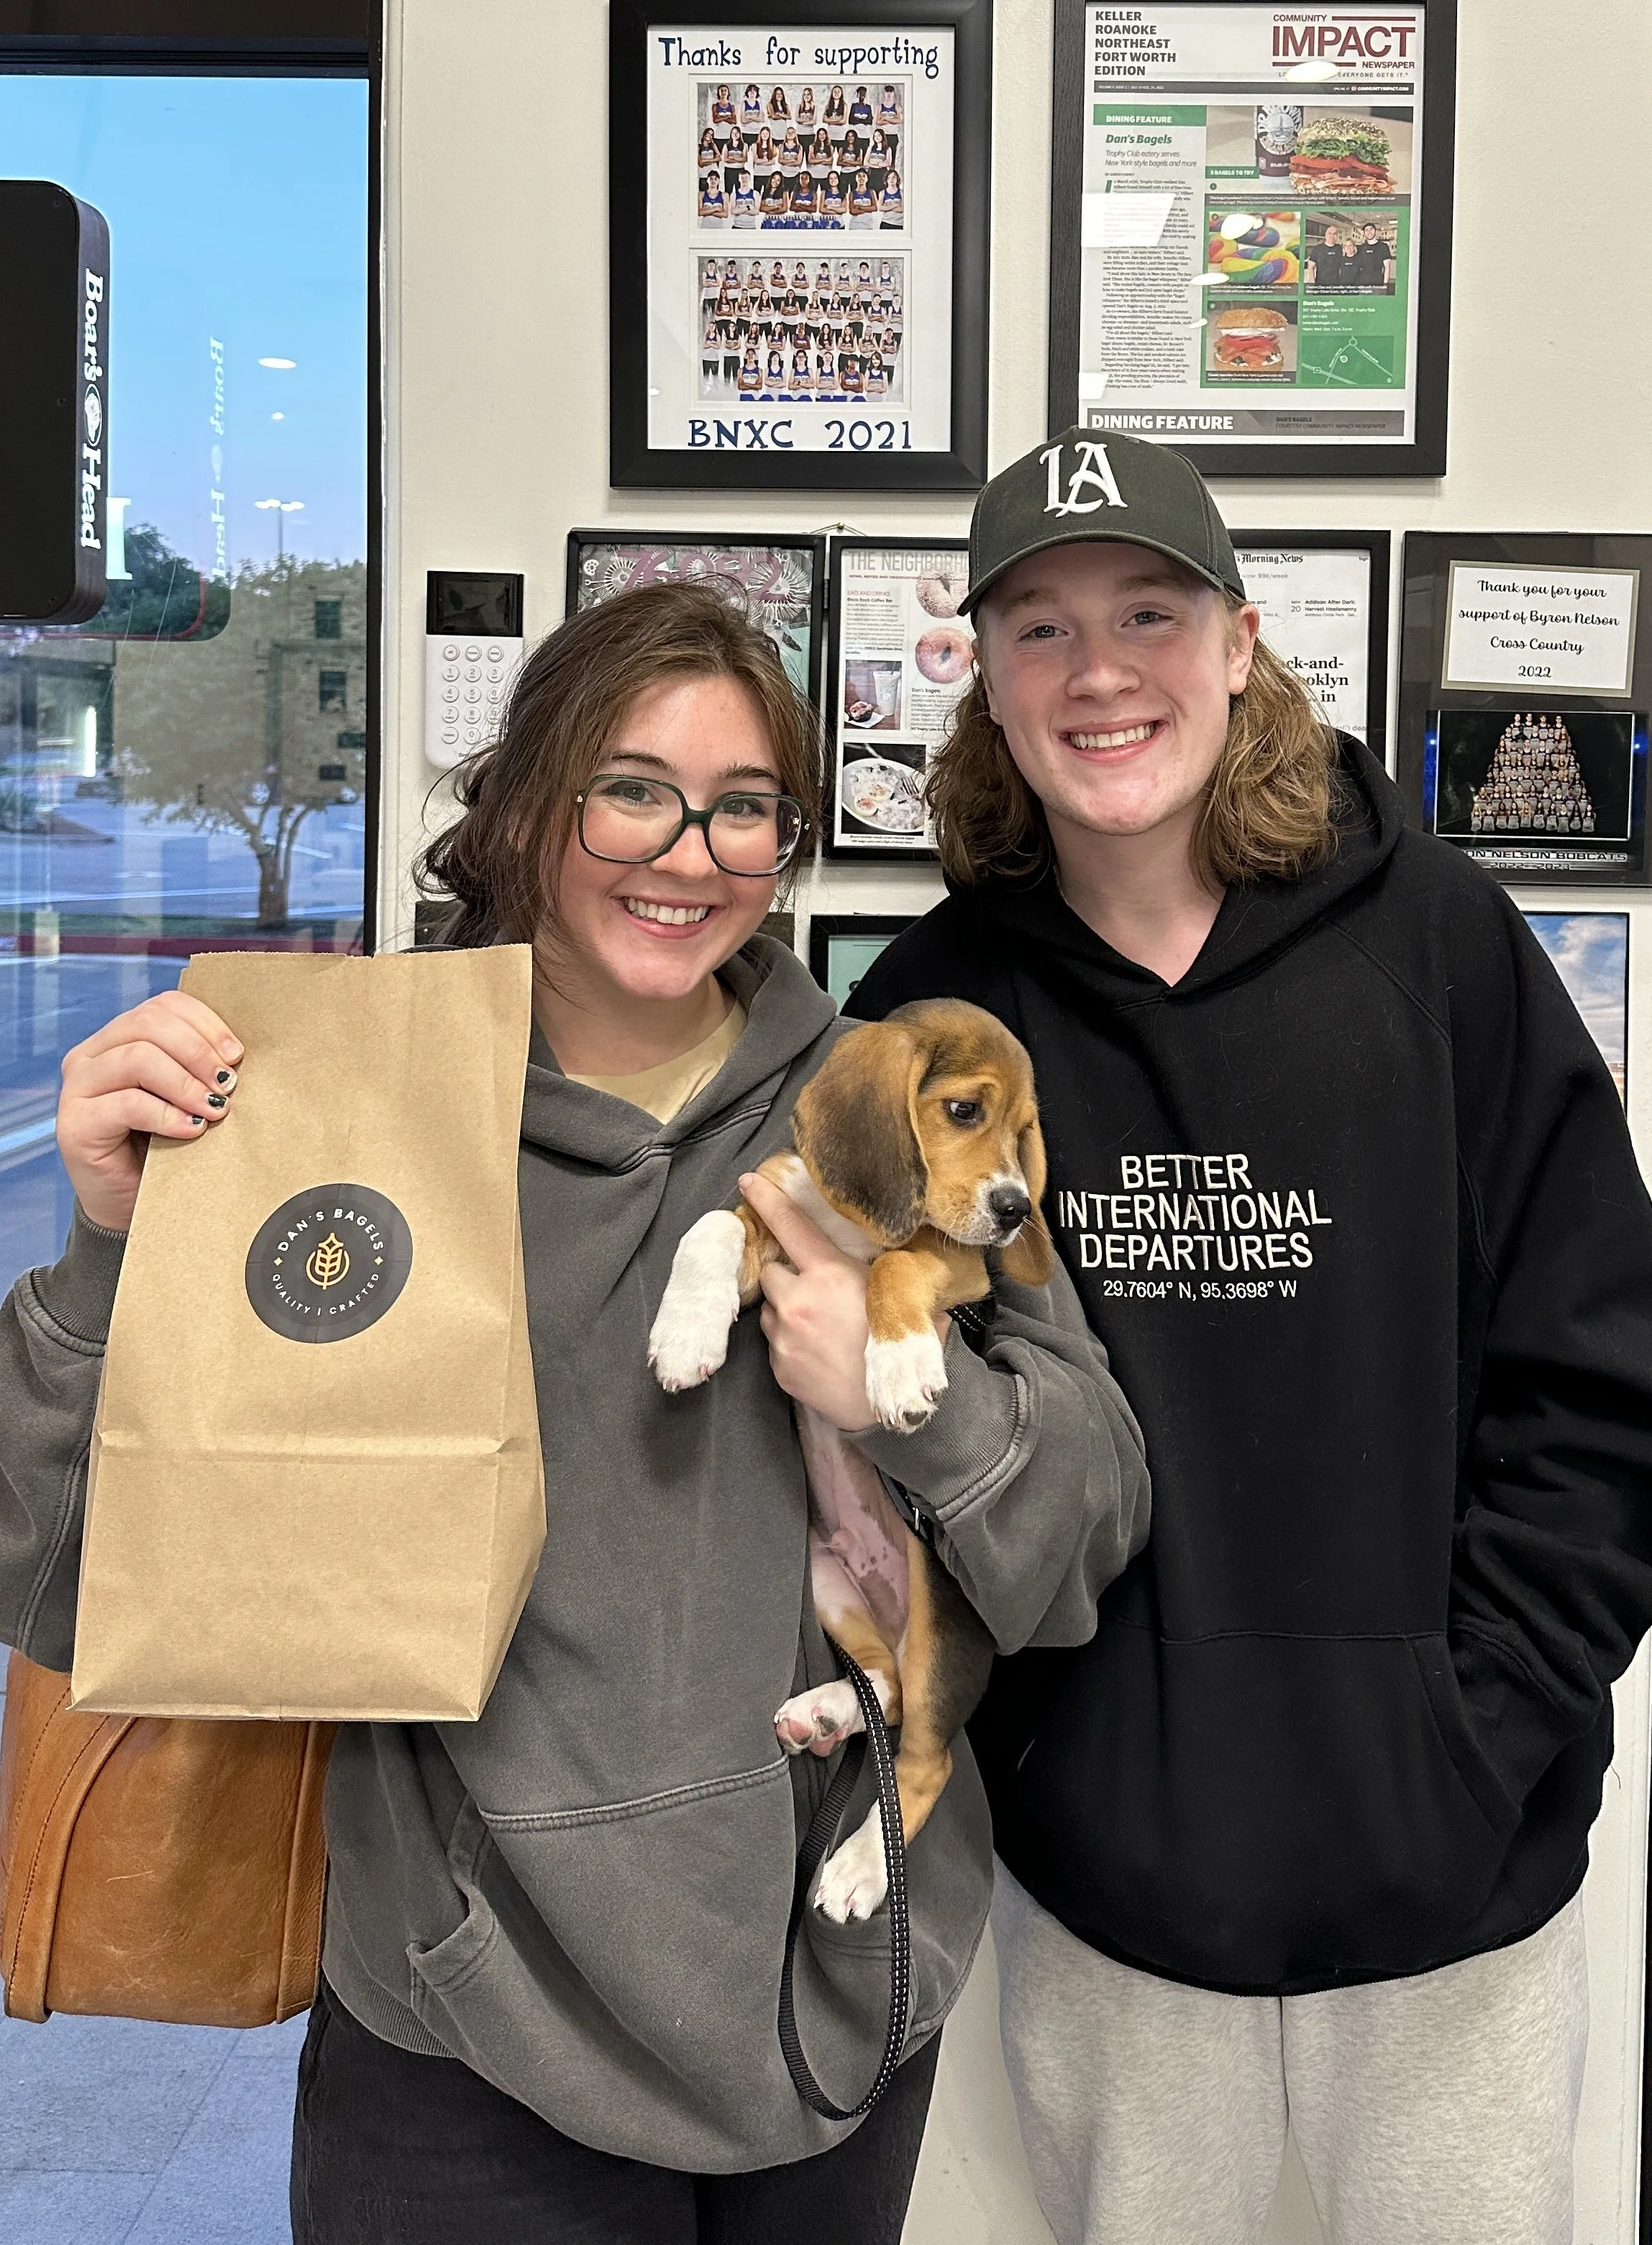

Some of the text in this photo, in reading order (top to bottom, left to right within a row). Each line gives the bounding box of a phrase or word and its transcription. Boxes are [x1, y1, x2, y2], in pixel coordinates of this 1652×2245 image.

[1095, 11, 1142, 22] KELLER
[1095, 24, 1157, 35] ROANOKE
[1095, 38, 1170, 49] NORTHEAST
[1272, 26, 1415, 58] IMPACT
[658, 35, 939, 79] Thanks for supporting
[1095, 52, 1177, 63] FORT WORTH
[1094, 65, 1146, 76] EDITION
[1105, 134, 1172, 146] Dan's Bagels
[1149, 160, 1169, 168] bagels
[81, 268, 104, 549] Boar's Head
[1091, 414, 1233, 431] DINING FEATURE
[688, 419, 911, 451] BNXC 2021
[1039, 440, 1128, 518] LA
[849, 550, 876, 570] THE
[1241, 553, 1279, 565] Morning
[1280, 553, 1304, 565] News
[1477, 579, 1607, 599] Thank you for your
[1459, 609, 1620, 627] support of Byron Nelson
[1490, 636, 1584, 653] Cross Country
[1287, 656, 1344, 669] ck-and-
[1518, 665, 1552, 678] 2022
[1306, 673, 1348, 688] oklyn
[1320, 689, 1336, 702] in
[1488, 850, 1551, 859] NELSON
[1556, 852, 1626, 861] BOBCATS
[1121, 1153, 1253, 1190] BETTER
[1058, 1189, 1332, 1231] INTERNATIONAL
[278, 1208, 384, 1252] DAN'S BAGELS
[1080, 1232, 1313, 1271] DEPARTURES
[273, 1273, 379, 1315] QUALITY CRAFTED
[1103, 1280, 1297, 1301] 29.7604° N, 95.3698° W
